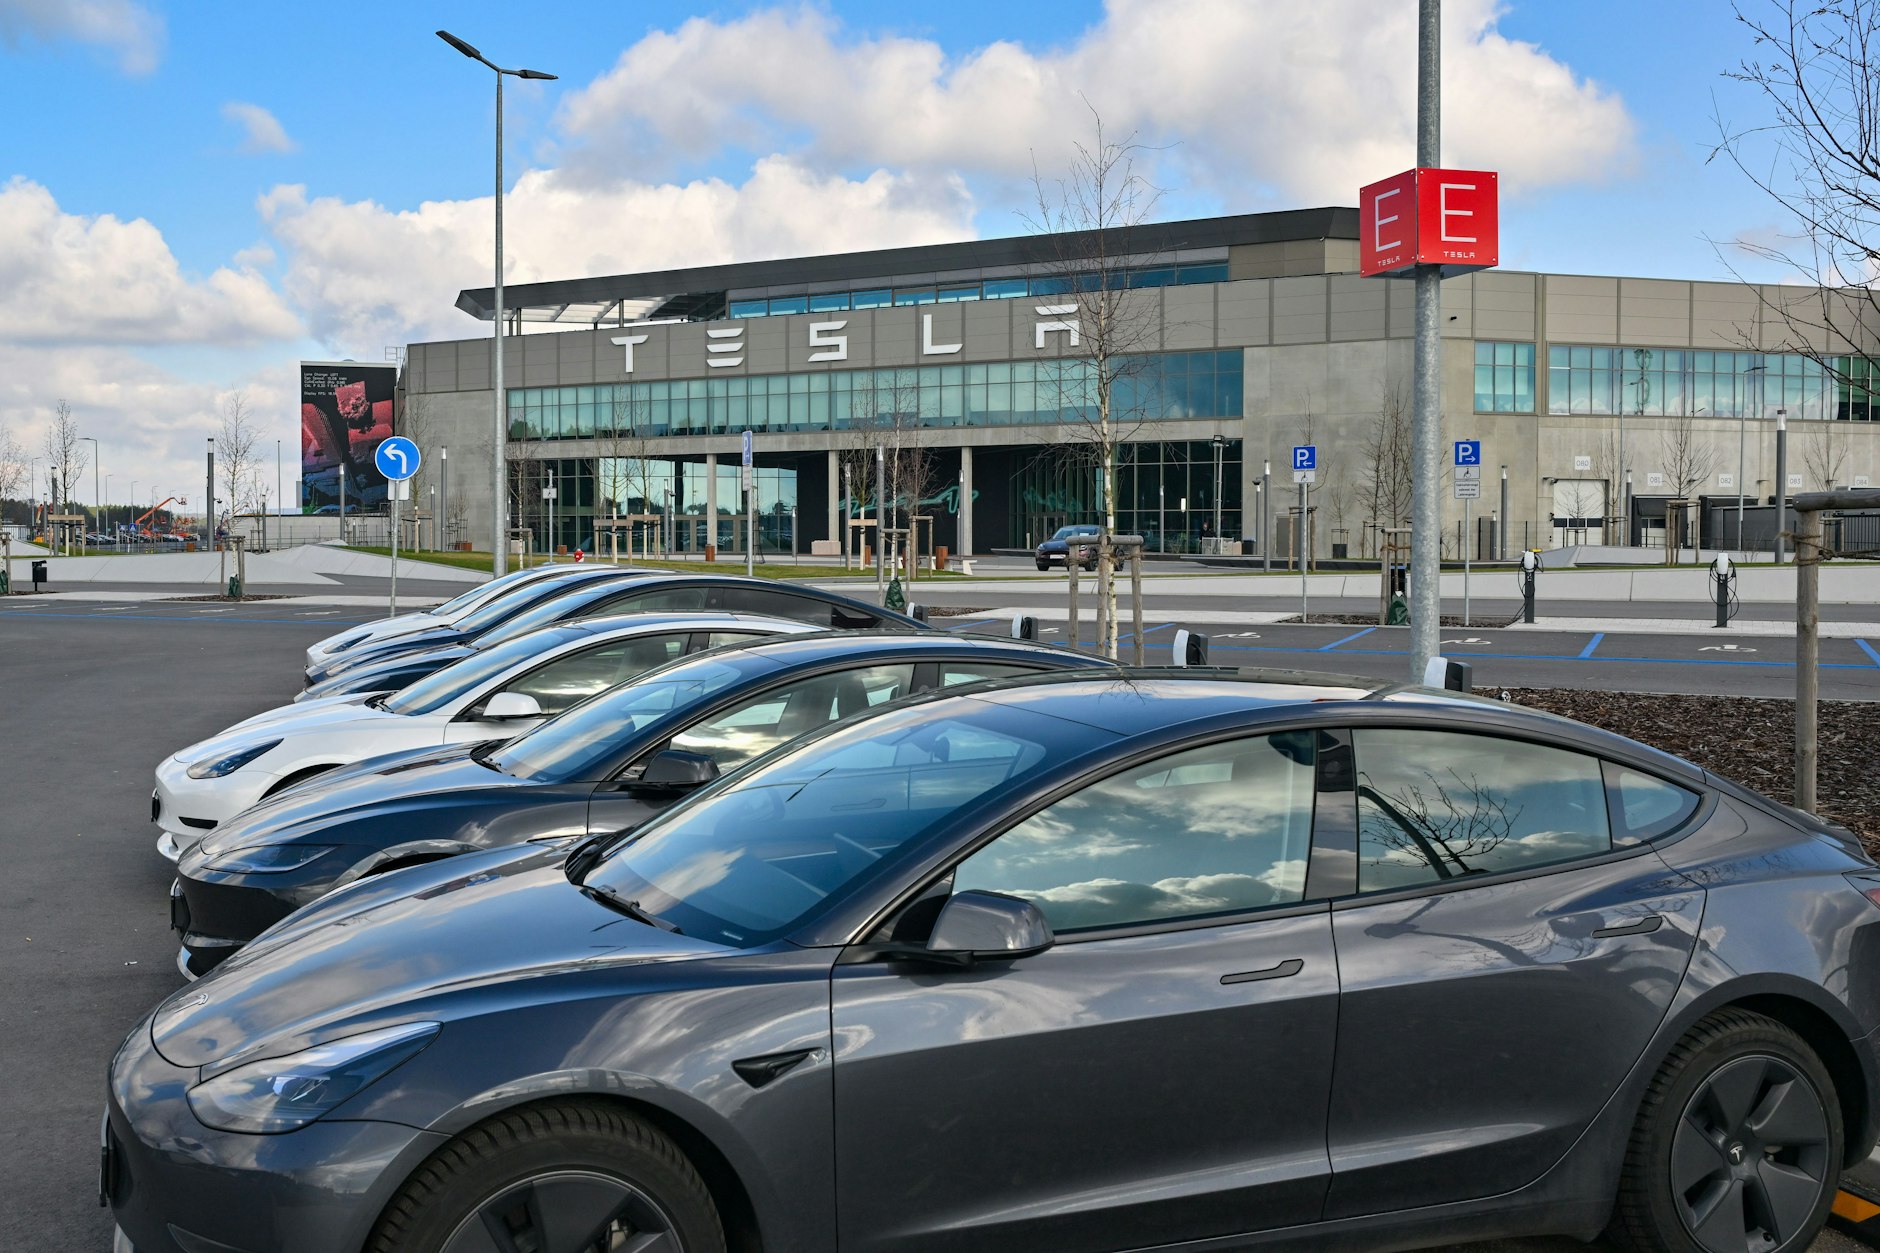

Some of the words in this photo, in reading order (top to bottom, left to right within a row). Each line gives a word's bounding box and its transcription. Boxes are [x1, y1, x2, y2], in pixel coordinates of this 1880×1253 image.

[1375, 188, 1401, 252] E
[1440, 183, 1477, 242] E
[1377, 255, 1400, 267] TESLA
[1443, 251, 1475, 259] TESLA
[610, 303, 1081, 374] TESLA
[1297, 449, 1309, 467] P
[1459, 443, 1473, 463] P
